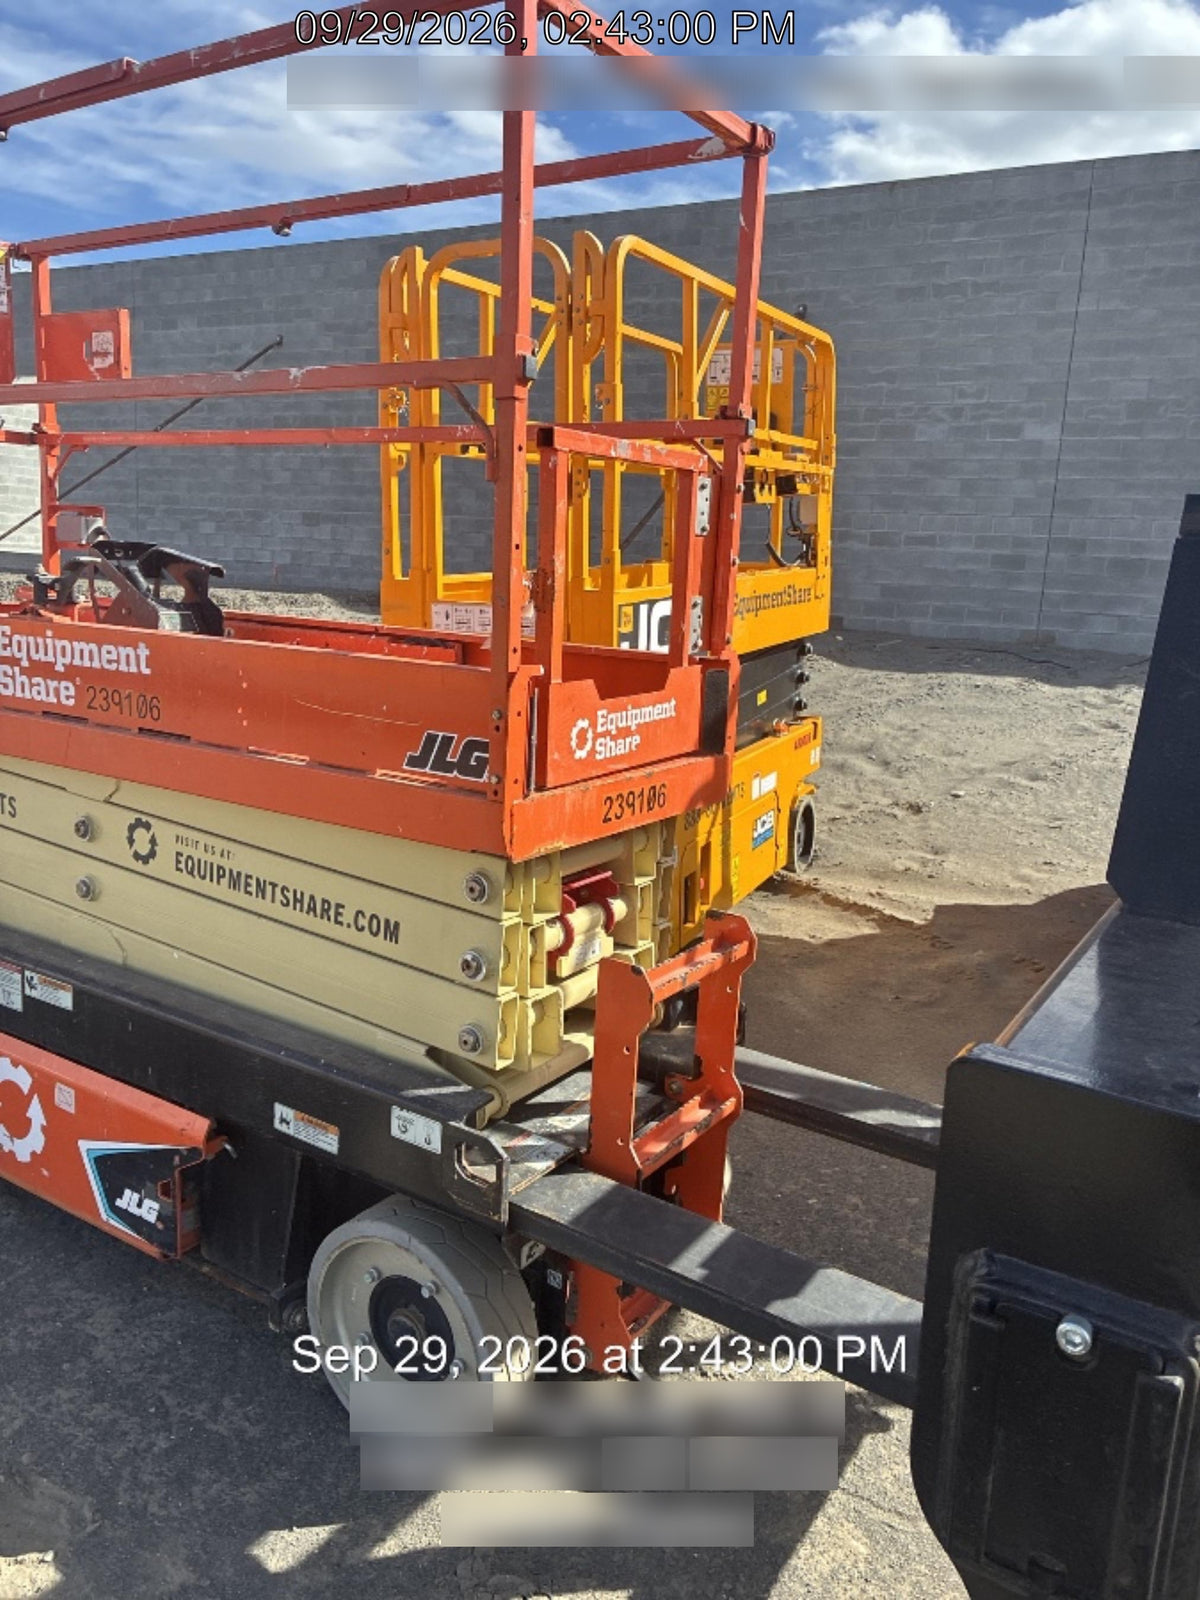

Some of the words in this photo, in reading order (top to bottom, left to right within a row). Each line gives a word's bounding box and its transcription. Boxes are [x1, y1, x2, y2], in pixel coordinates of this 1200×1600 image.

[0, 625, 151, 674] Equipment
[0, 664, 76, 706] Share
[86, 685, 161, 721] 239106
[597, 697, 676, 734] Equipment
[402, 730, 489, 782] JLG
[595, 734, 641, 760] Share
[601, 783, 667, 824] 239106
[175, 834, 200, 850] VISIT
[204, 843, 216, 856] US
[174, 851, 401, 945] EQUIPMENTSHARE.COM
[115, 1188, 160, 1224] JLG
